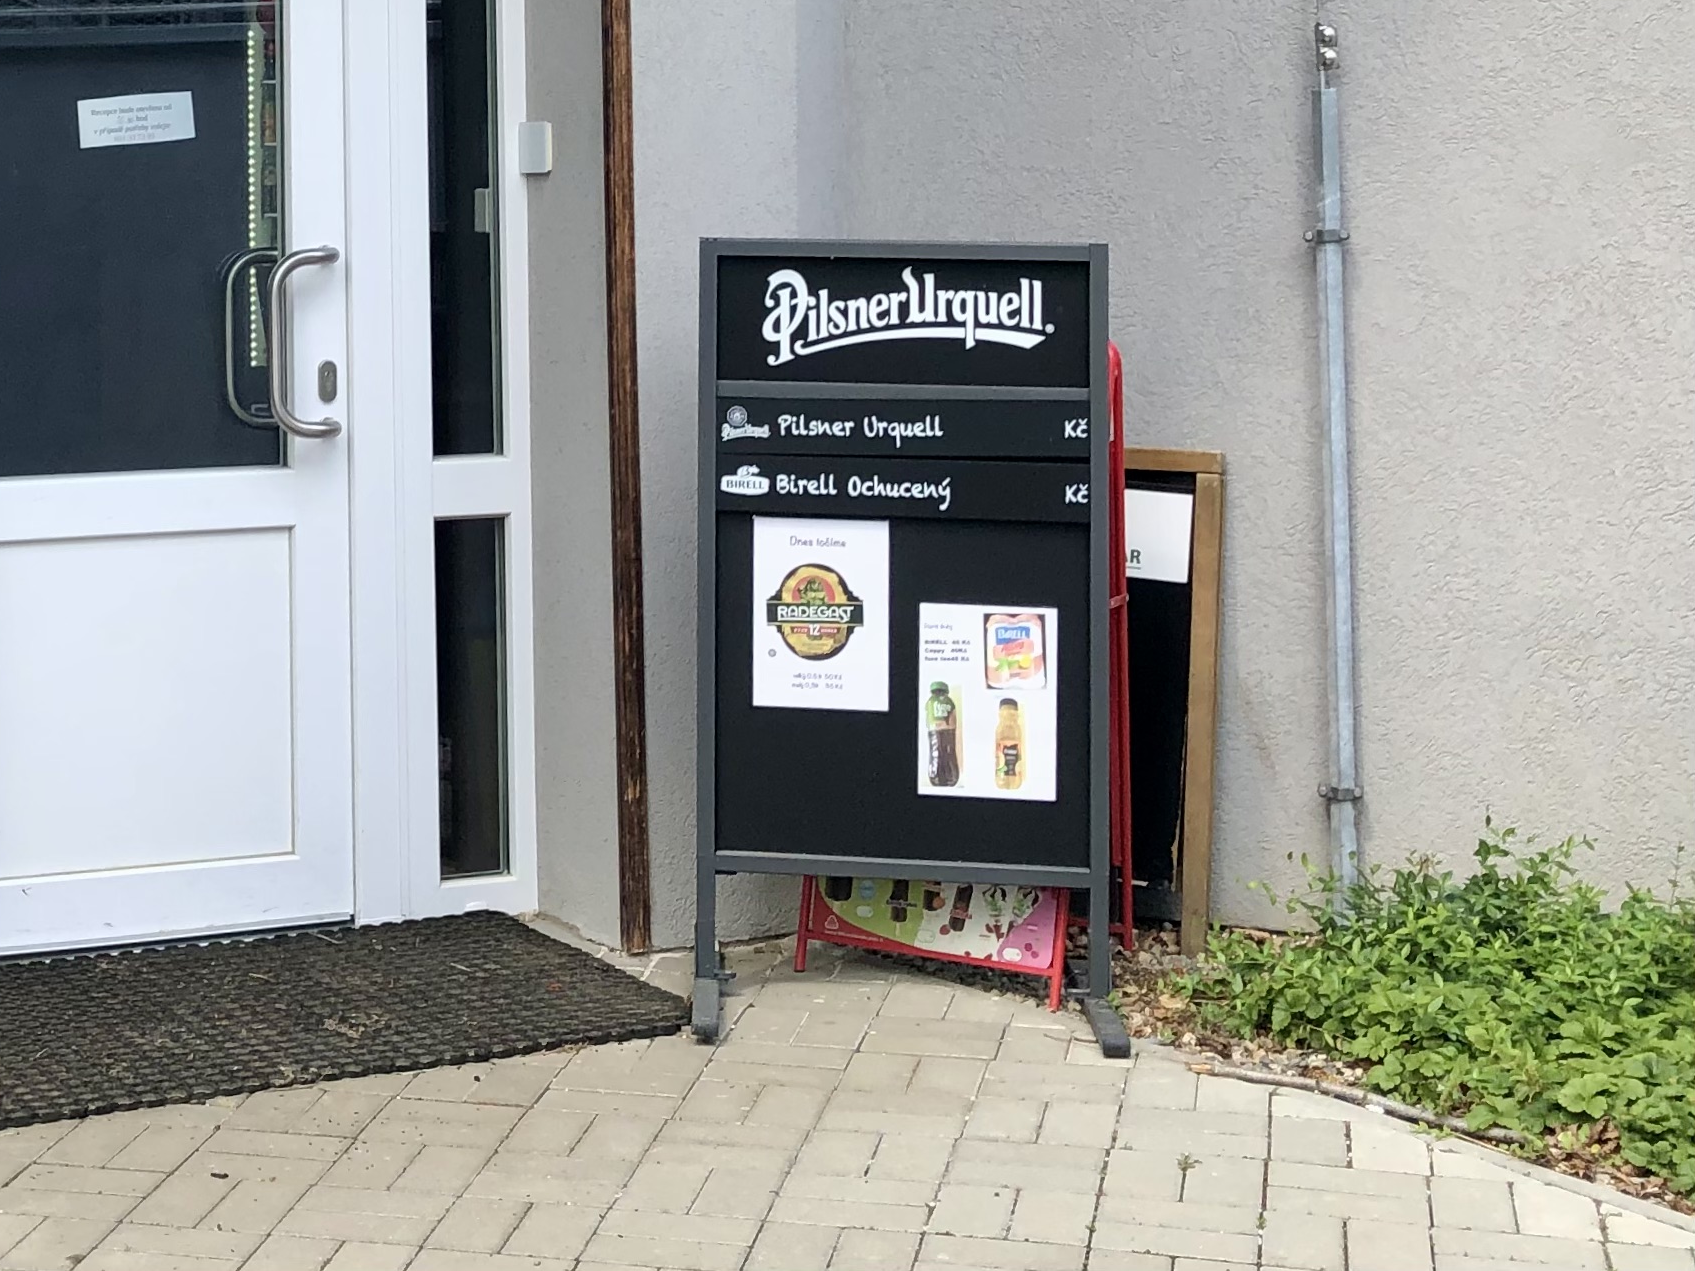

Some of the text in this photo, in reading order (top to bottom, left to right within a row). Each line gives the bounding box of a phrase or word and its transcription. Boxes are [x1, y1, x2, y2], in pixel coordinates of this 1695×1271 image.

[761, 266, 1045, 366] Pilsner Urquell
[777, 413, 1089, 448] Pilsner Urquell Kč
[725, 479, 766, 492] BIRELL
[776, 473, 1089, 511] Birell Ochucený Kč
[789, 535, 813, 547] Dnes
[777, 606, 854, 623] RADEGAST
[809, 624, 821, 636] 12
